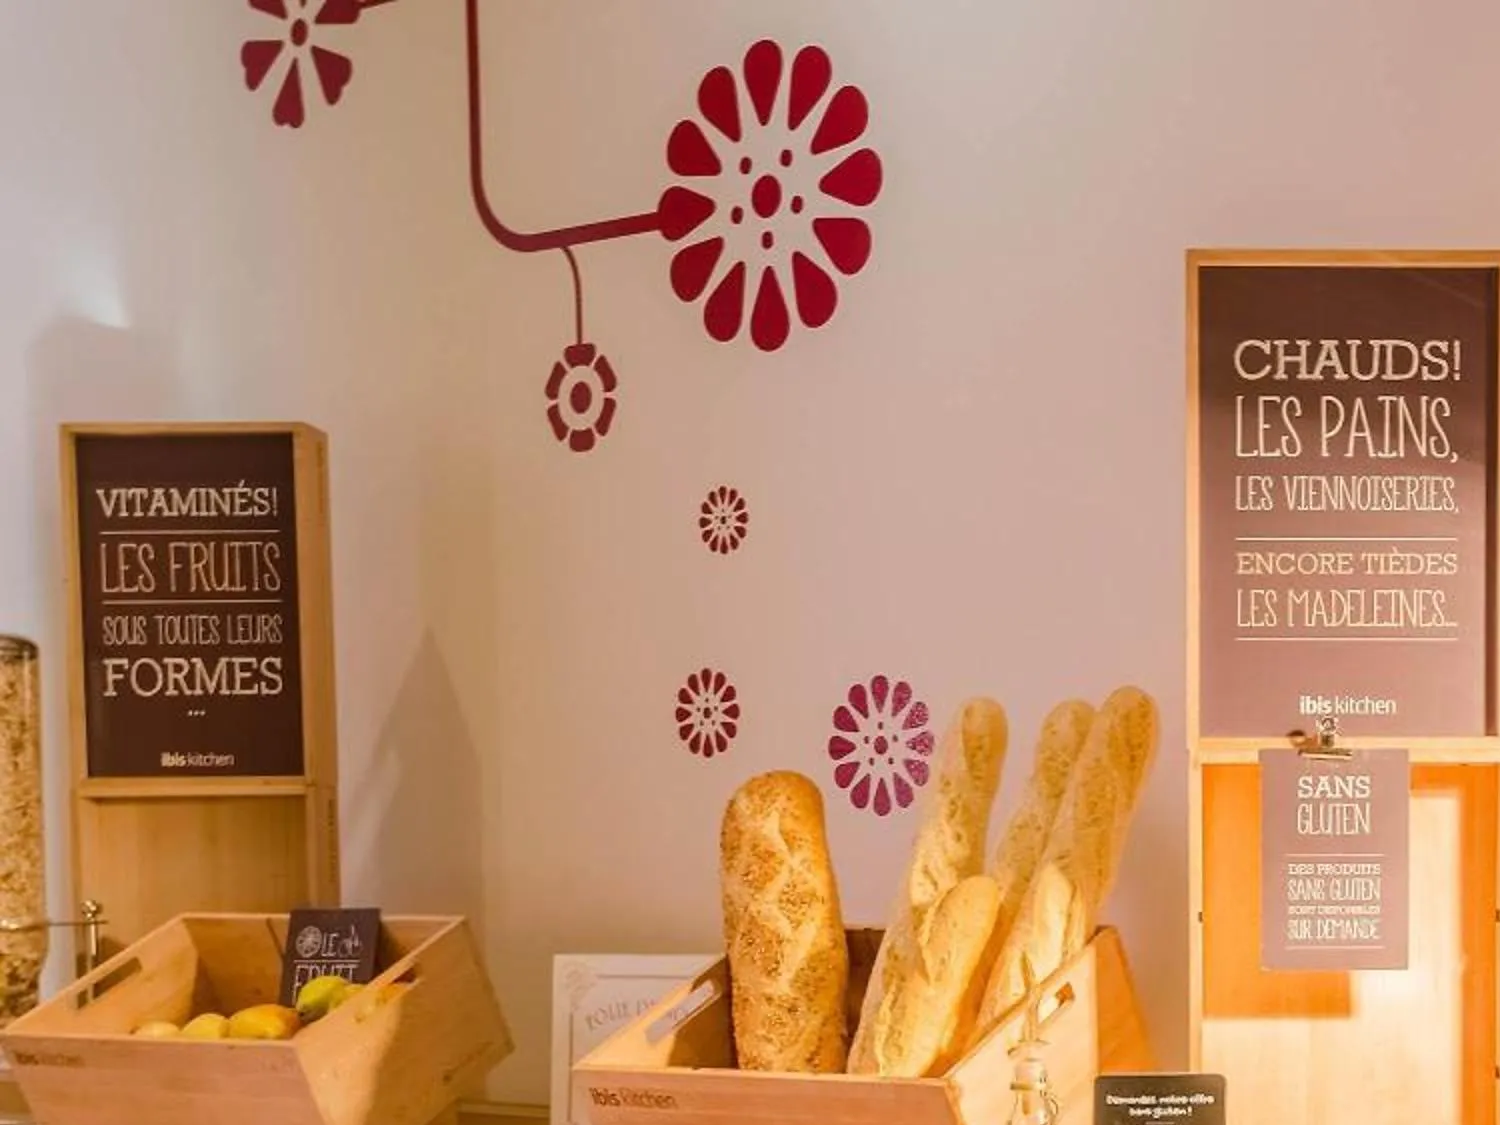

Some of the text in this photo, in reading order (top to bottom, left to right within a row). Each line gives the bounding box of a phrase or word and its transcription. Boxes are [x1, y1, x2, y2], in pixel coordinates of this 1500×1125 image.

[1233, 339, 1462, 381] CHAUDS!
[1235, 396, 1459, 463] LES PAINS,
[96, 479, 277, 518] VITAMINÉS!
[1235, 475, 1459, 513] LES VIENNOISERIES,
[101, 541, 281, 593] LES FRUITS
[1237, 547, 1458, 576] ENCORE TIÈDES
[1237, 589, 1277, 628] LES
[103, 615, 282, 645] SOUS TOUTES LEURS
[103, 656, 282, 697] FORMES
[1300, 695, 1397, 714] ibis kitchen
[1298, 775, 1371, 799] SANS
[1297, 803, 1370, 835] GLUTEN
[1317, 864, 1380, 875] PRODUITS
[1287, 879, 1380, 900] SANS GLUTEN
[321, 932, 339, 957] LE
[1287, 919, 1381, 939] SUR DEMANDE
